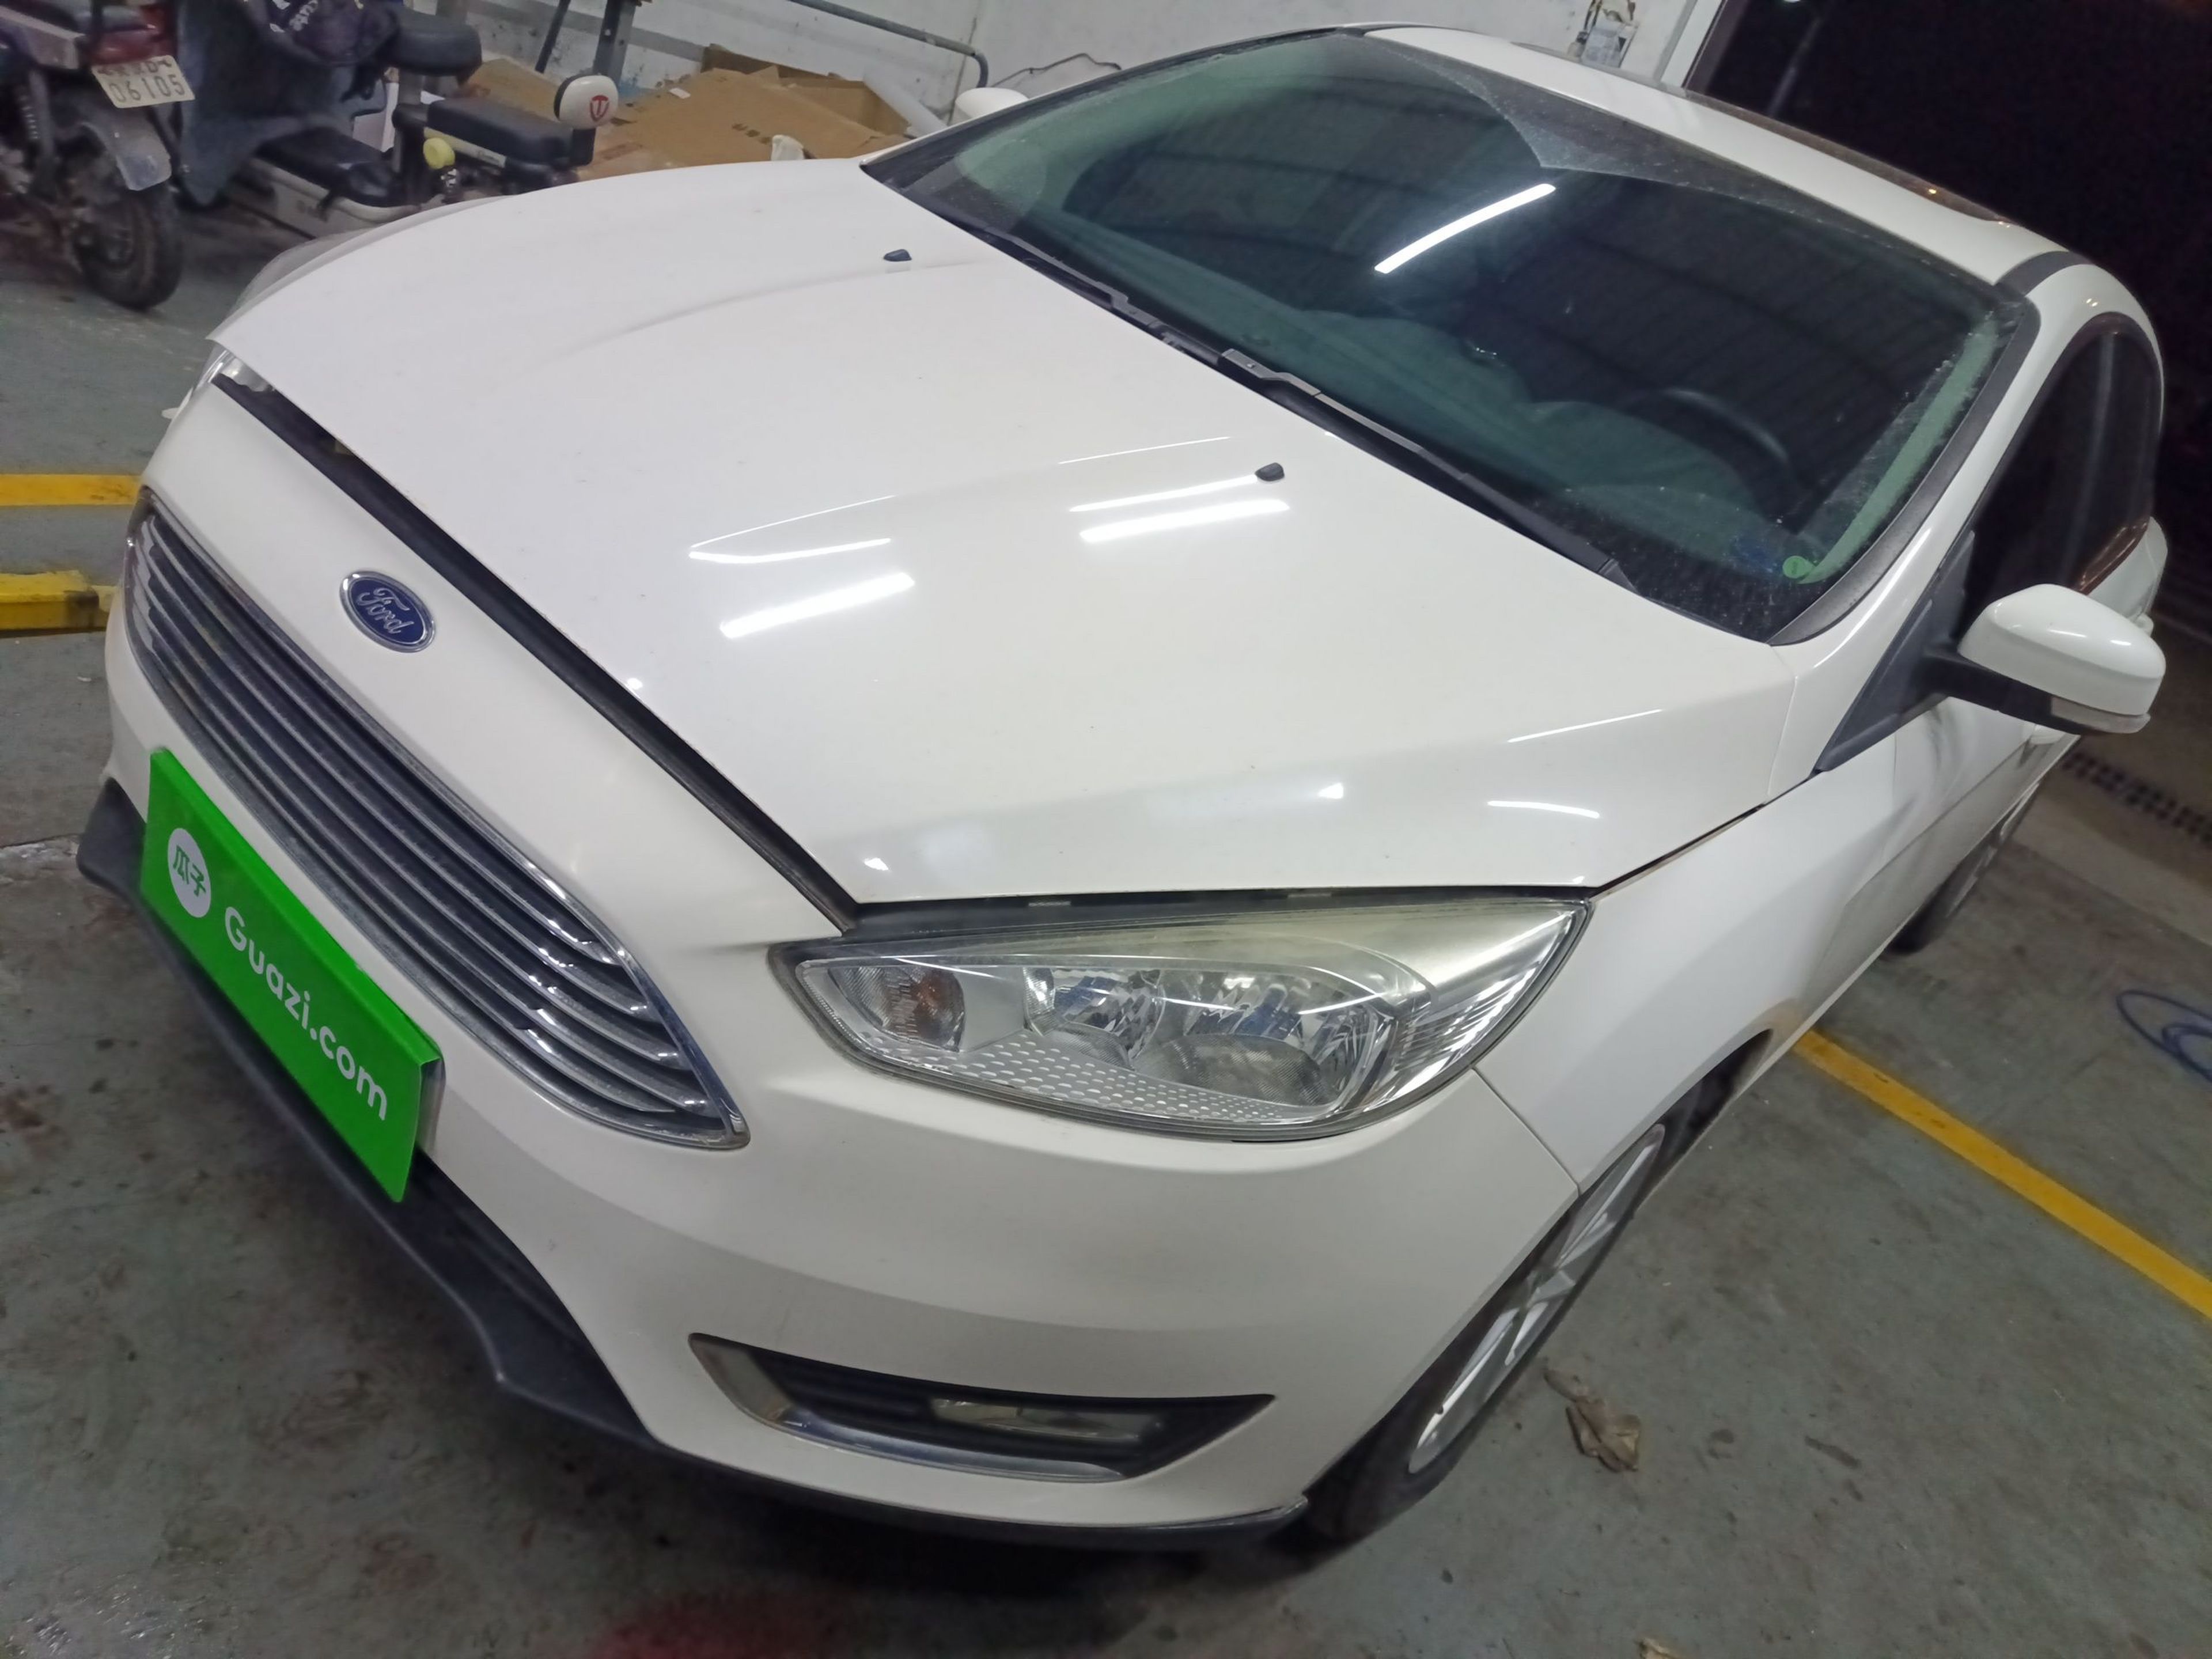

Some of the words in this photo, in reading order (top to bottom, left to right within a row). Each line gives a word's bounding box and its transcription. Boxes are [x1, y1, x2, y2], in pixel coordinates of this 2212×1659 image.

[109, 74, 185, 103] 06105
[357, 587, 414, 634] Ford
[173, 844, 206, 897] 瓜子
[225, 906, 388, 1121] Guazi.com
